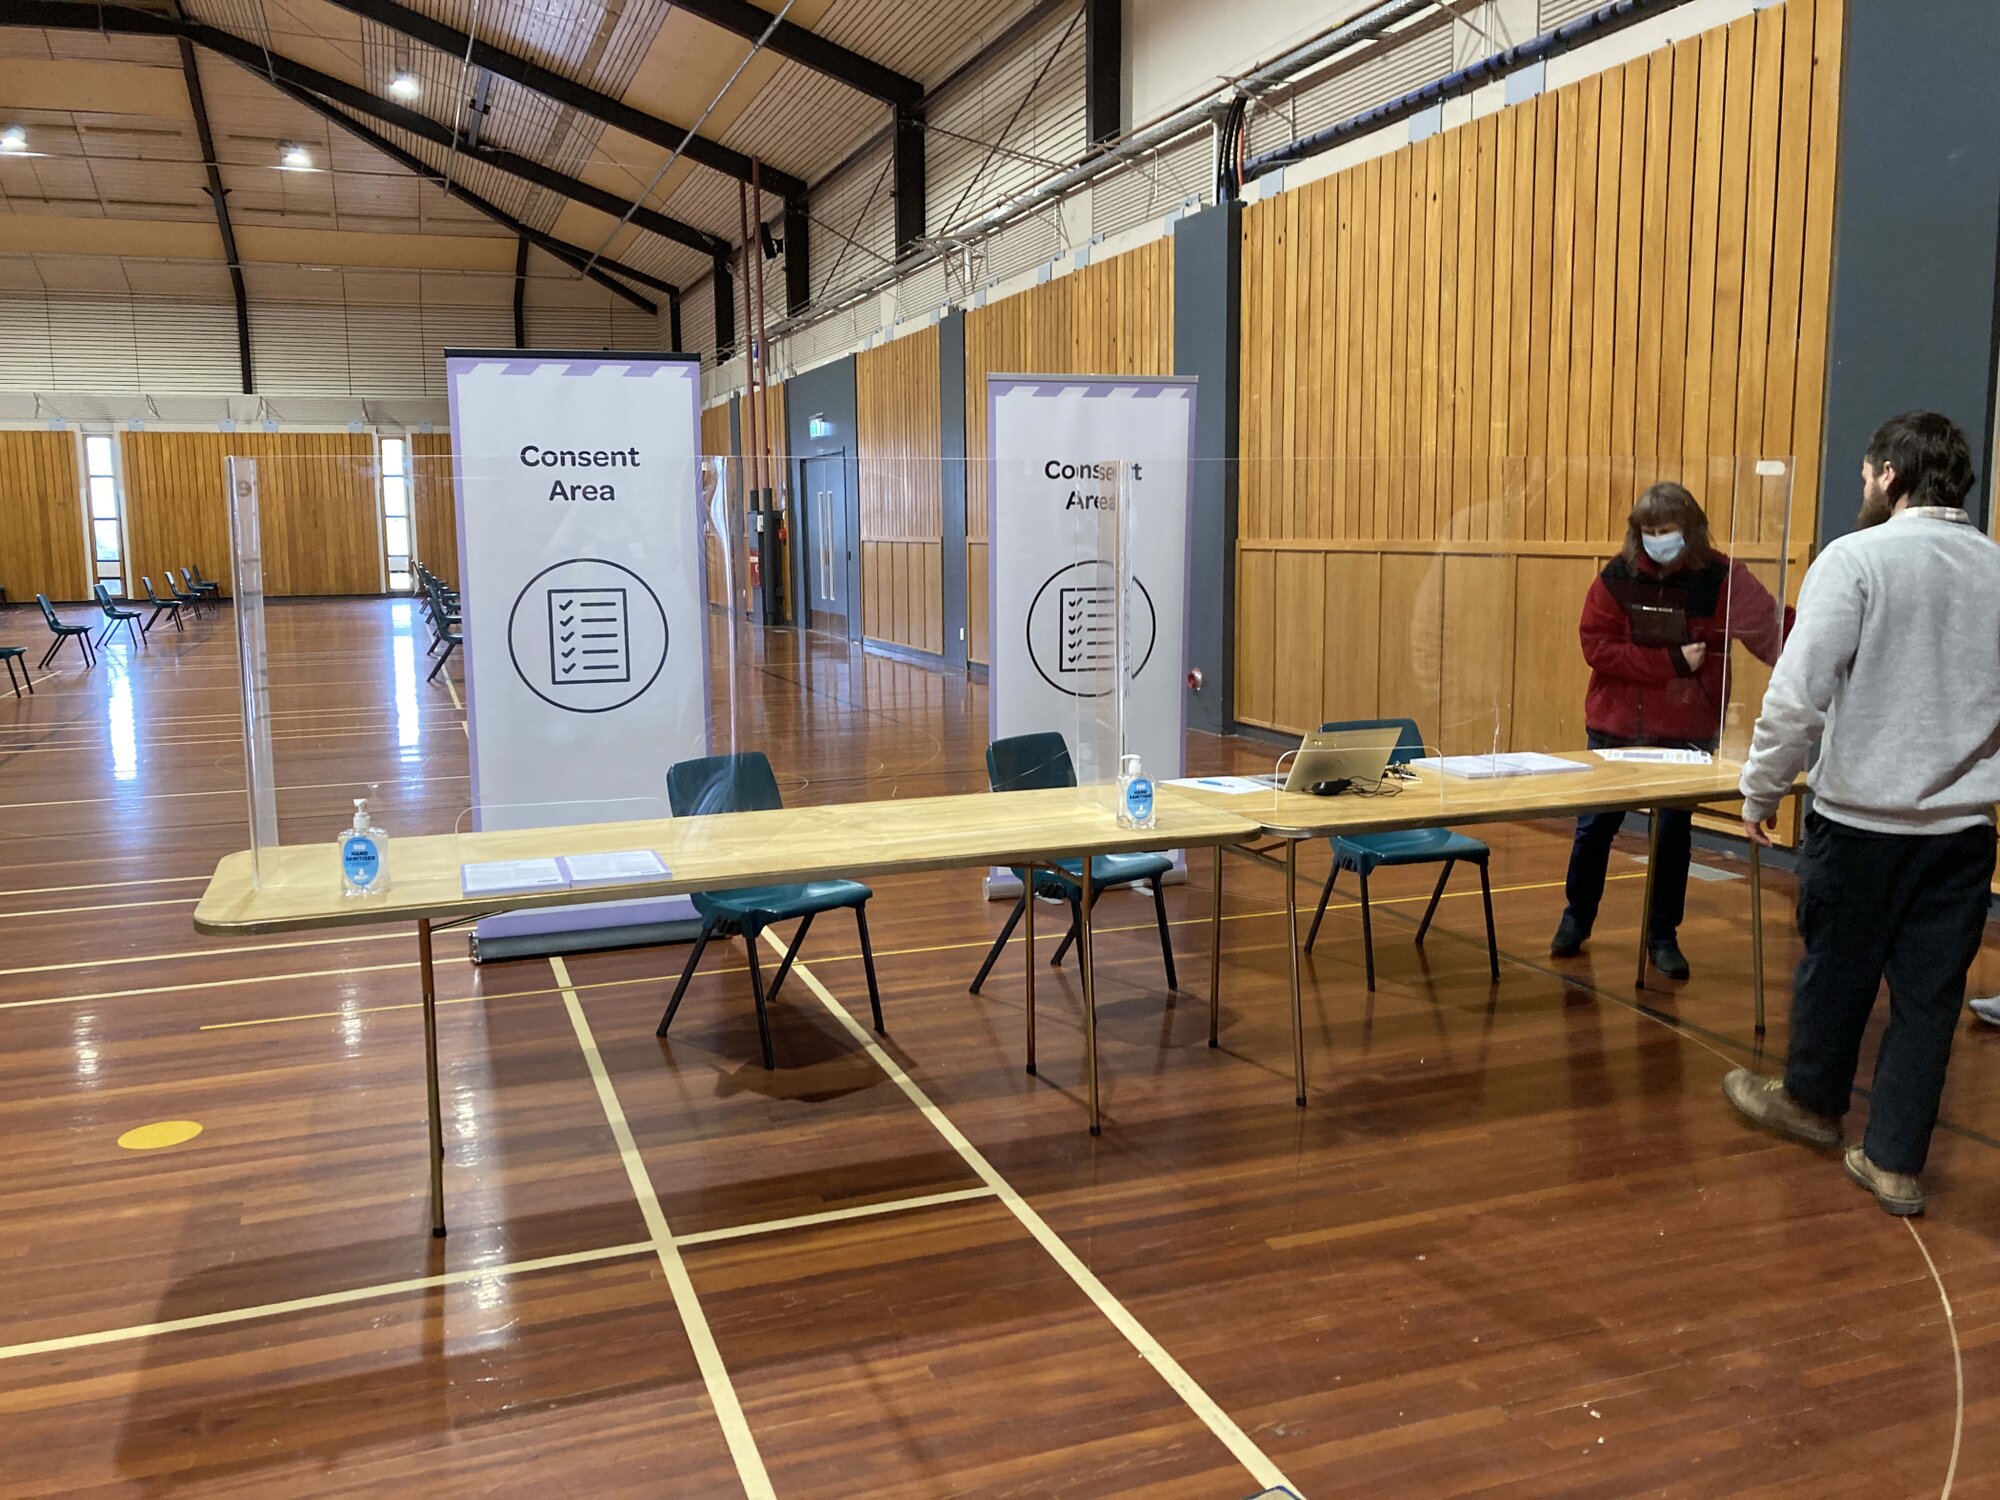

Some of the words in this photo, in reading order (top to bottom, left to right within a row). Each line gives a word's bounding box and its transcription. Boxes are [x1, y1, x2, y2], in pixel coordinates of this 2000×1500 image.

[520, 445, 640, 467] Consent
[1045, 460, 1142, 481] Conset
[549, 480, 615, 501] Area
